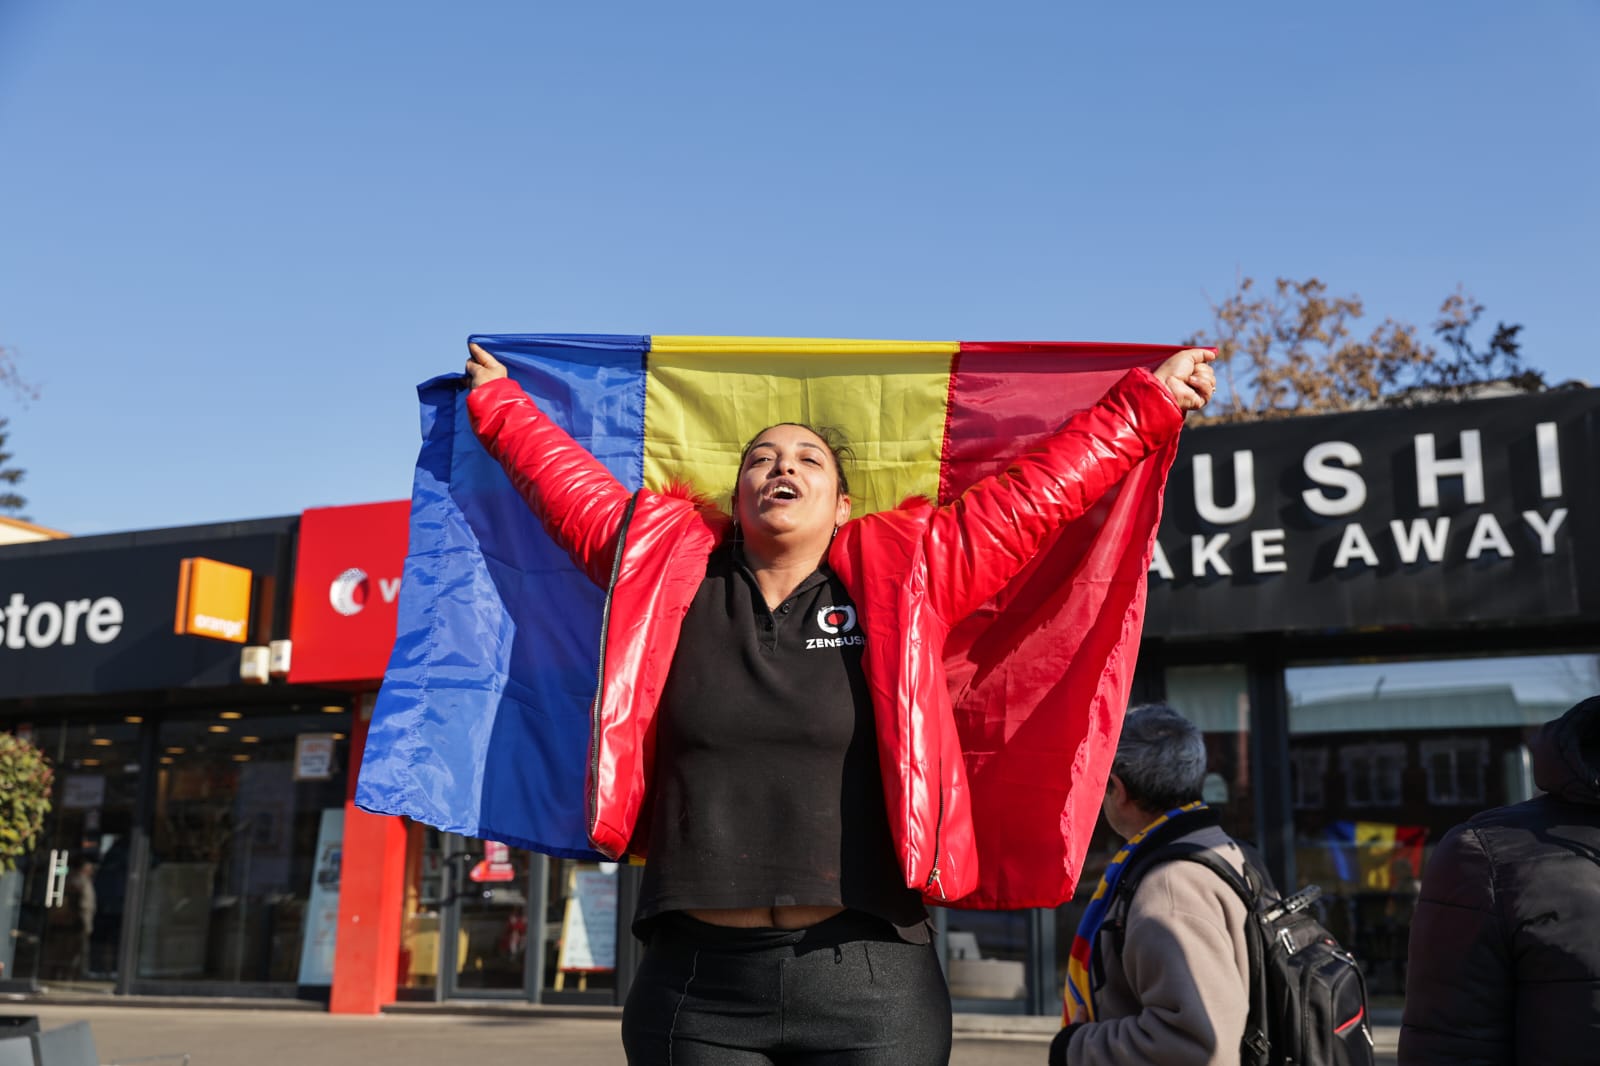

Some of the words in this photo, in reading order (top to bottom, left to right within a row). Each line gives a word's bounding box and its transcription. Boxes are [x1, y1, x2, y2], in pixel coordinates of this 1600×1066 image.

[1192, 421, 1563, 525] USHI
[1148, 528, 1288, 579] AKE
[1333, 508, 1568, 569] AWAY
[0, 592, 124, 650] tore
